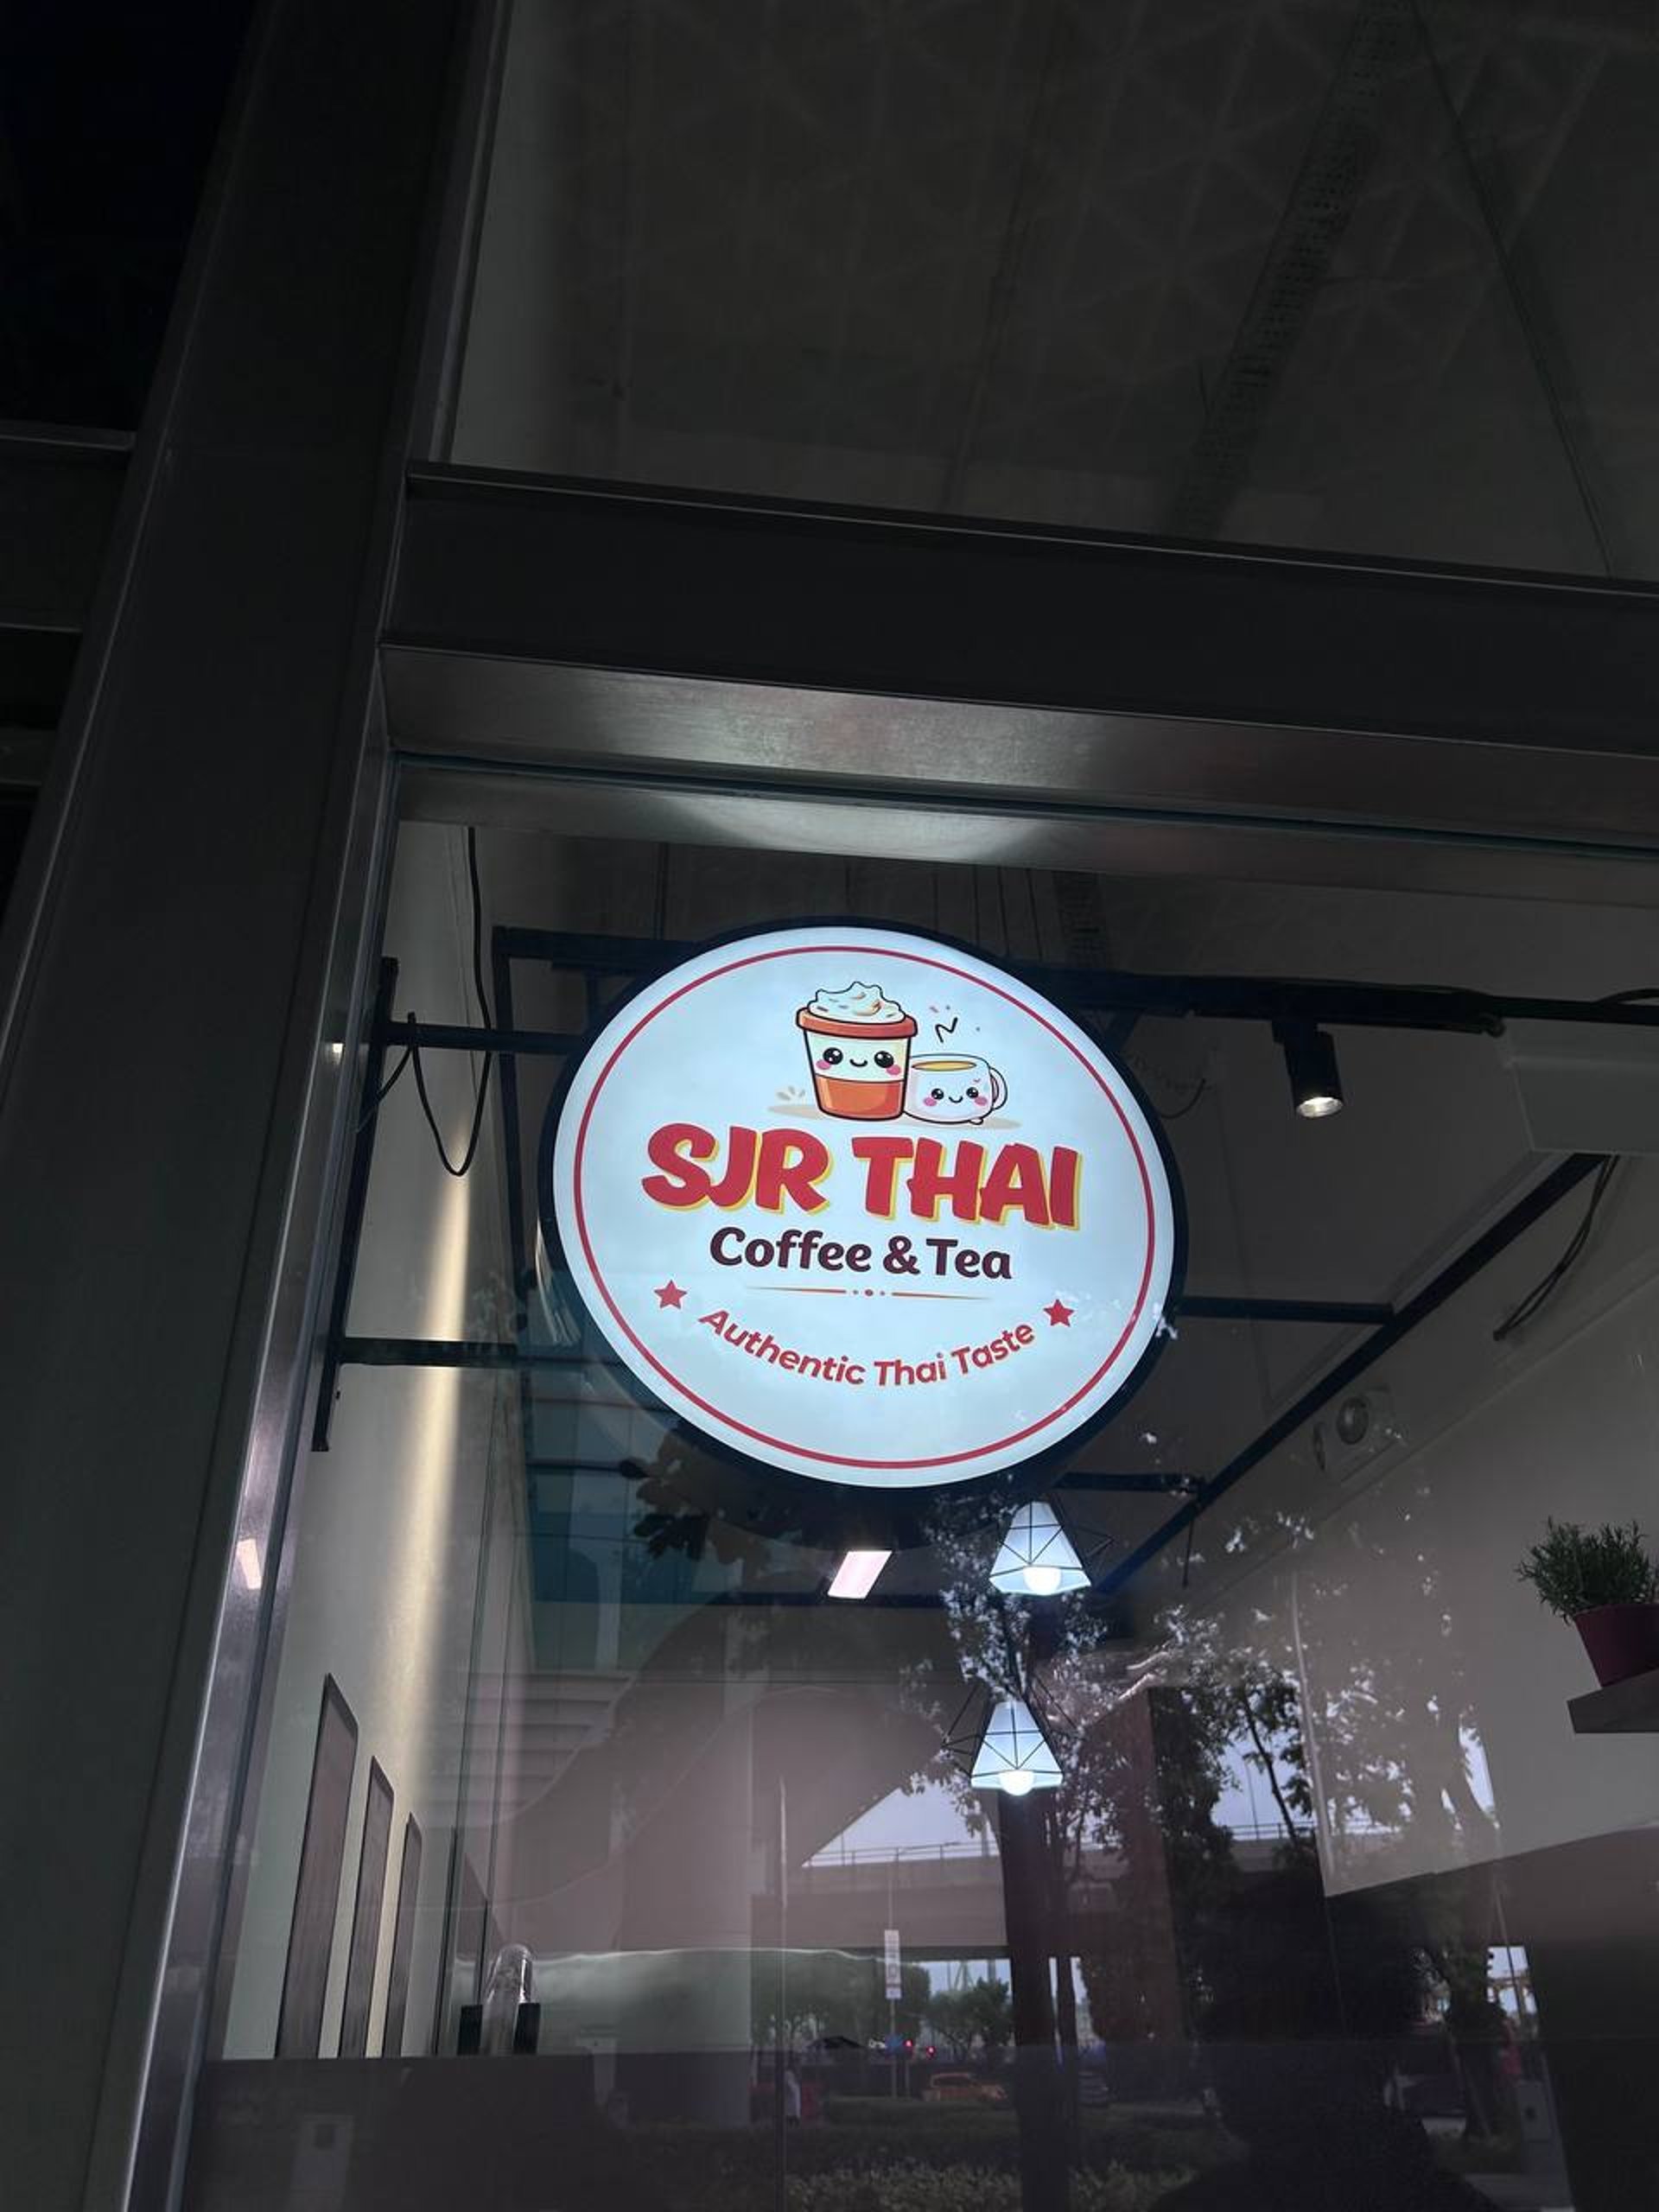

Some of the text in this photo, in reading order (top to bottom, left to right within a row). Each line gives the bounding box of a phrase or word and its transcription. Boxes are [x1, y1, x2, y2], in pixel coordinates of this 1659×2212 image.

[641, 1122, 1082, 1230] SJR THAI
[709, 1226, 1014, 1280] Coffee & Tea
[698, 1308, 1035, 1386] Authentic Thai Taste
